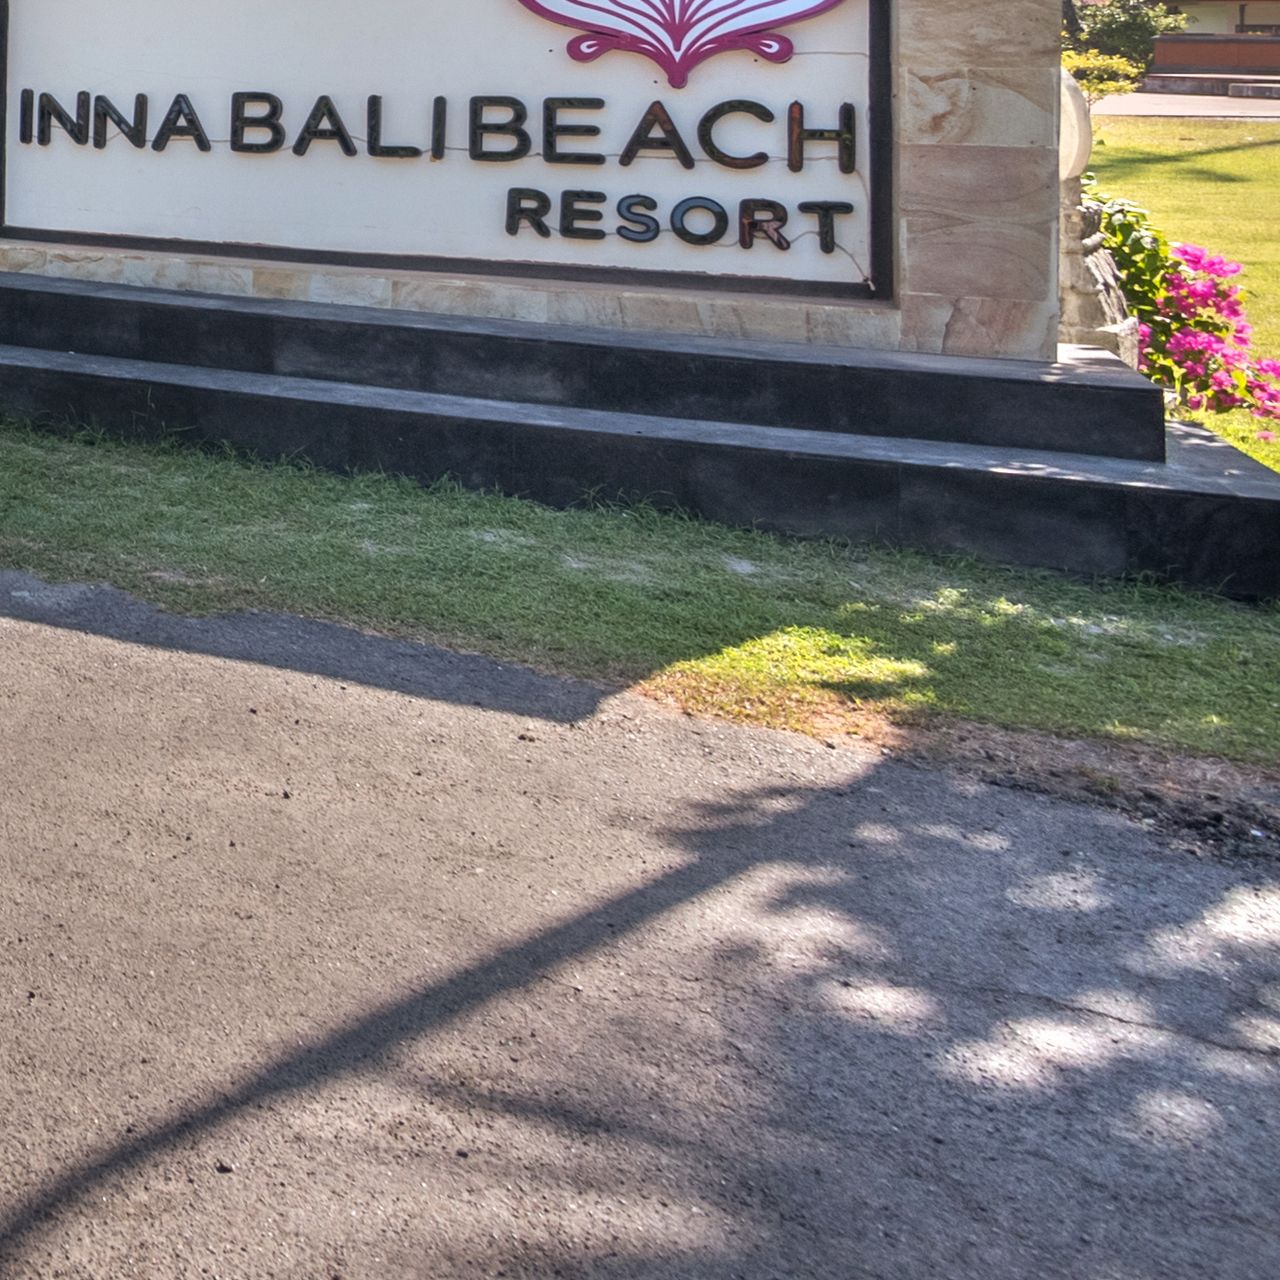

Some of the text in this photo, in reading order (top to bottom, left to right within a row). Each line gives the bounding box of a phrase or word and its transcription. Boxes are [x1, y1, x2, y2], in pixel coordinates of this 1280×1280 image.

[19, 88, 857, 174] INNA BALI BEACH
[505, 187, 854, 254] RESORT
